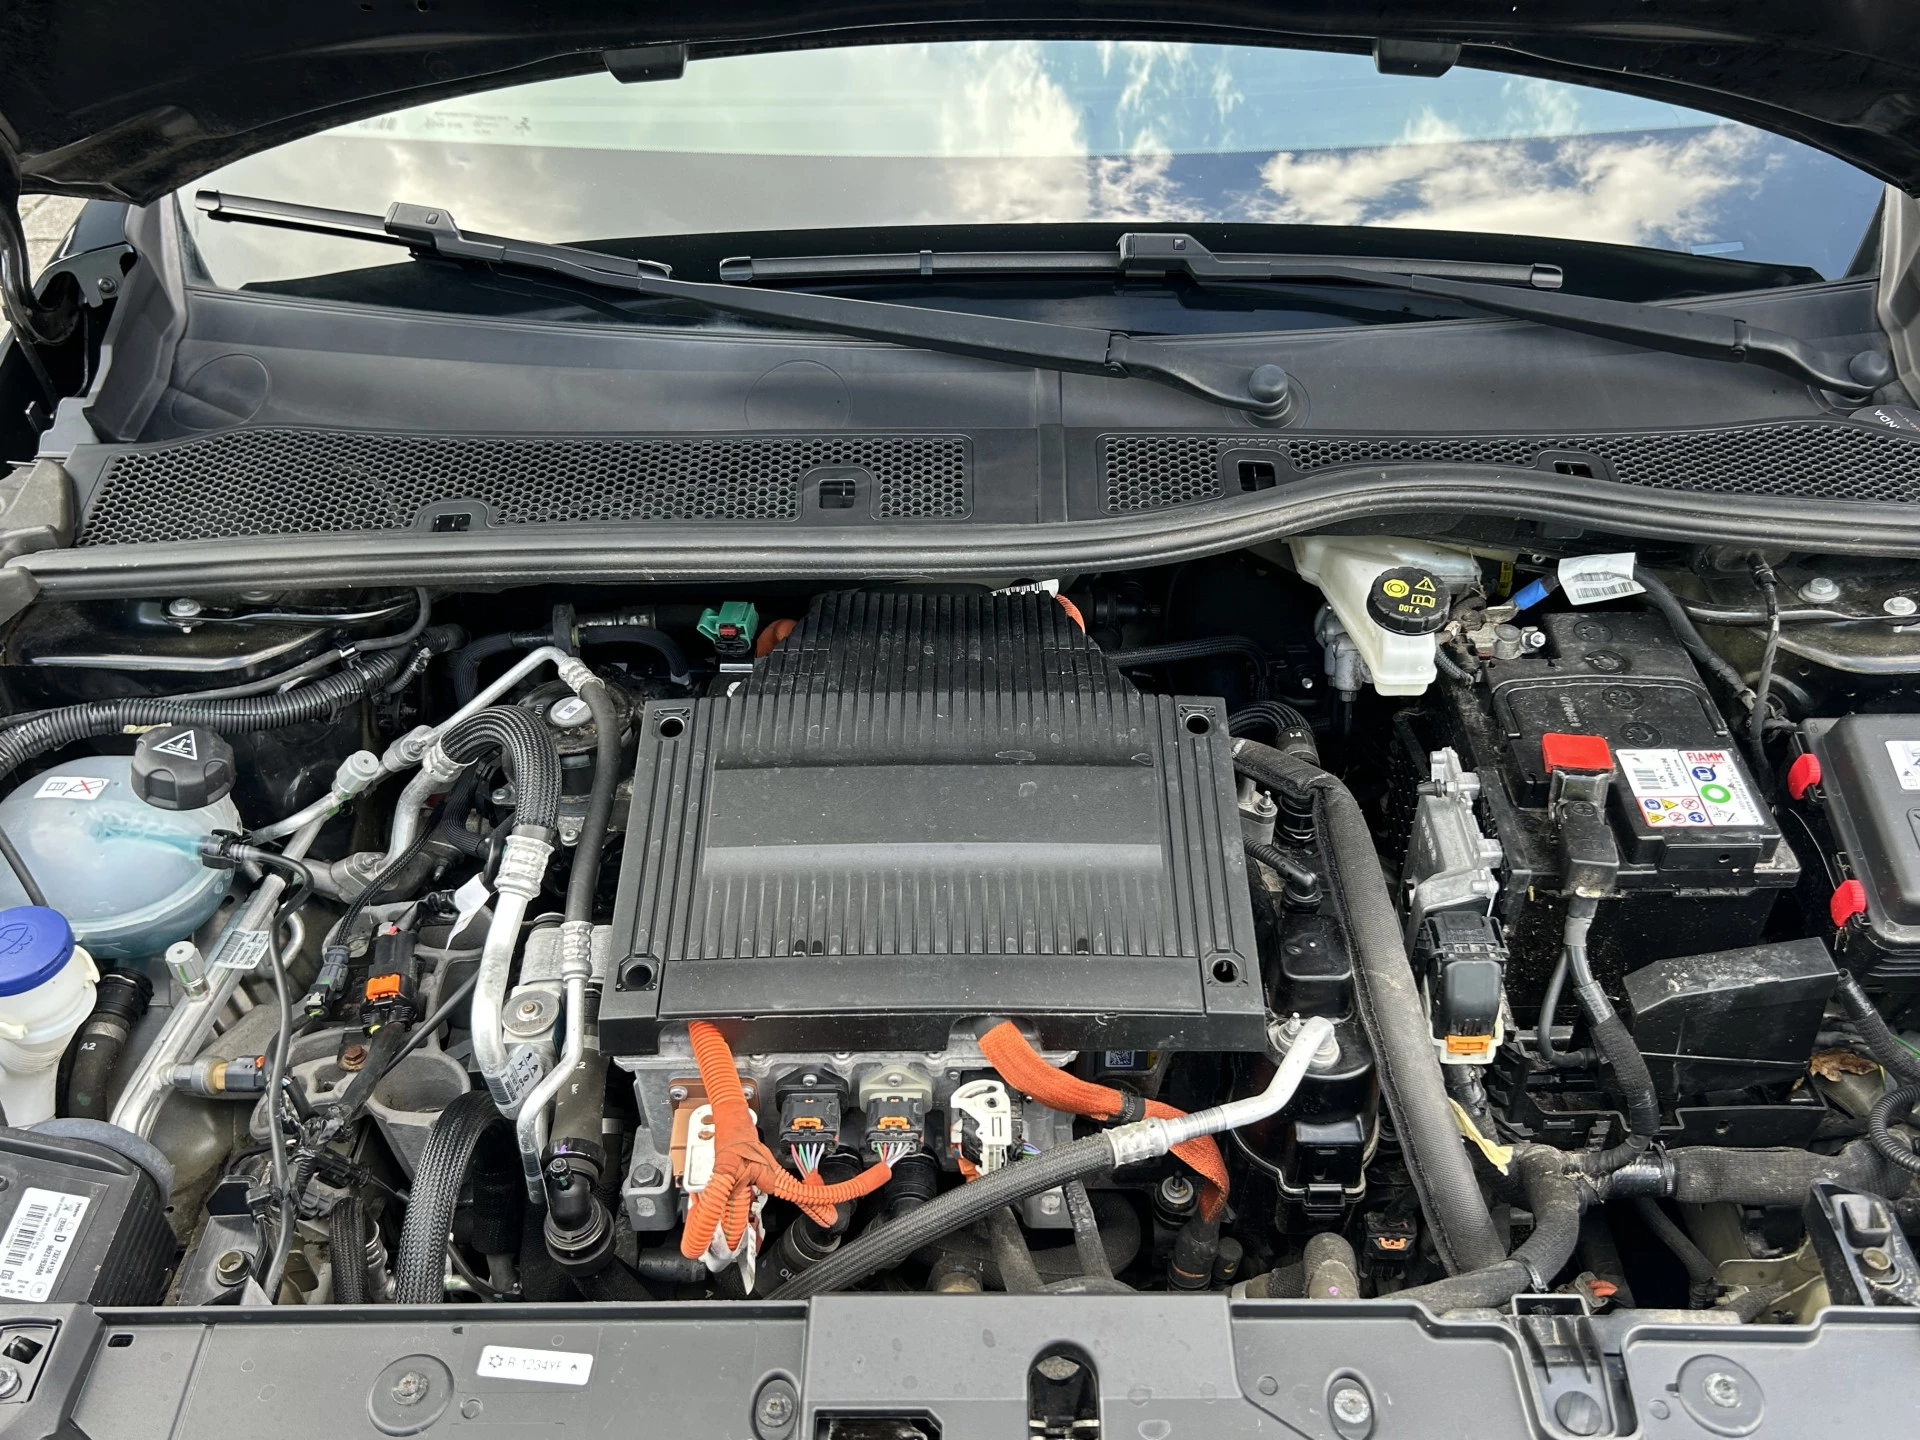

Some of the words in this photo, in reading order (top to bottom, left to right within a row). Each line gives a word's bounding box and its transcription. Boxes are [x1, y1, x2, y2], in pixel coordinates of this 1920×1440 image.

[1399, 604, 1414, 612] DOT
[1686, 752, 1725, 761] FIAMM
[80, 1042, 97, 1051] A2
[575, 1061, 587, 1069] 2
